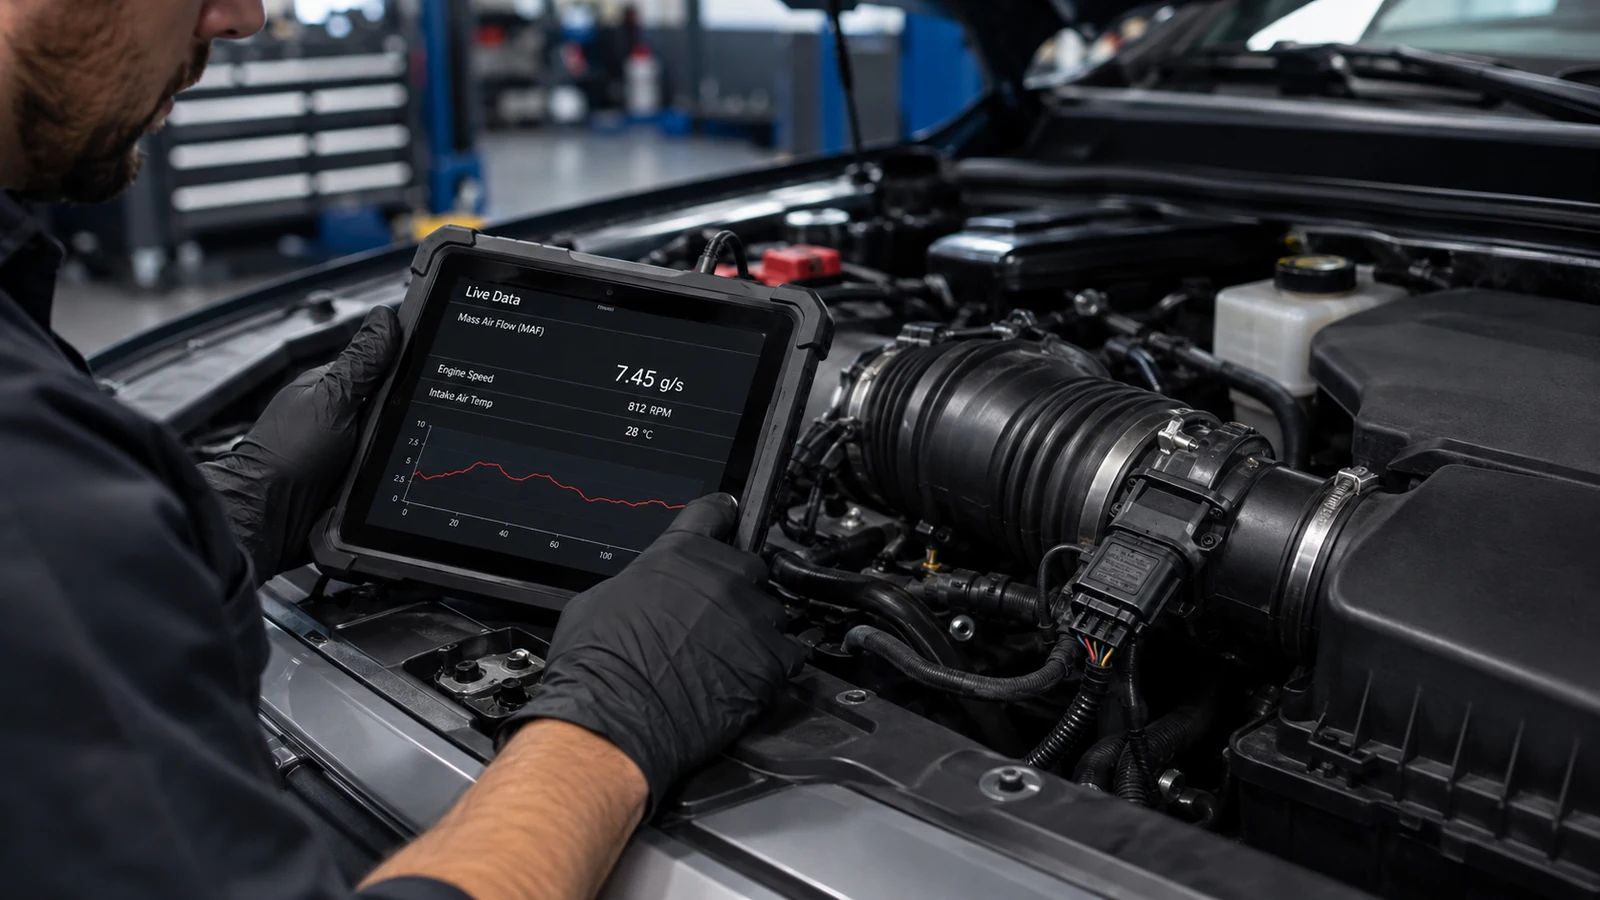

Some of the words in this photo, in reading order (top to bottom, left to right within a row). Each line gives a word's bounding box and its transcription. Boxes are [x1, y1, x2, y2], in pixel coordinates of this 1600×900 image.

[465, 285, 490, 301] Live
[492, 290, 521, 306] Data
[457, 312, 481, 325] Mass
[480, 316, 495, 327] Air
[495, 319, 517, 331] Flow
[517, 322, 545, 337] (MAF)
[437, 363, 466, 378] Engine
[466, 369, 495, 384] Speed
[615, 364, 657, 388] 7.45
[659, 376, 684, 393] g/s
[428, 387, 455, 401] Intake
[455, 393, 469, 403] Air
[470, 395, 494, 410] Temp
[627, 401, 647, 414] 812
[649, 405, 672, 418] RPM
[417, 420, 426, 428] 10
[625, 425, 639, 437] 28
[408, 437, 419, 446] 7.5
[405, 456, 412, 465] 5
[393, 474, 406, 483] 2.5
[392, 494, 398, 503] 0
[401, 508, 408, 516] 0
[448, 518, 460, 527] 20
[498, 529, 509, 538] 40
[549, 540, 560, 549] 60
[599, 551, 613, 560] 100
